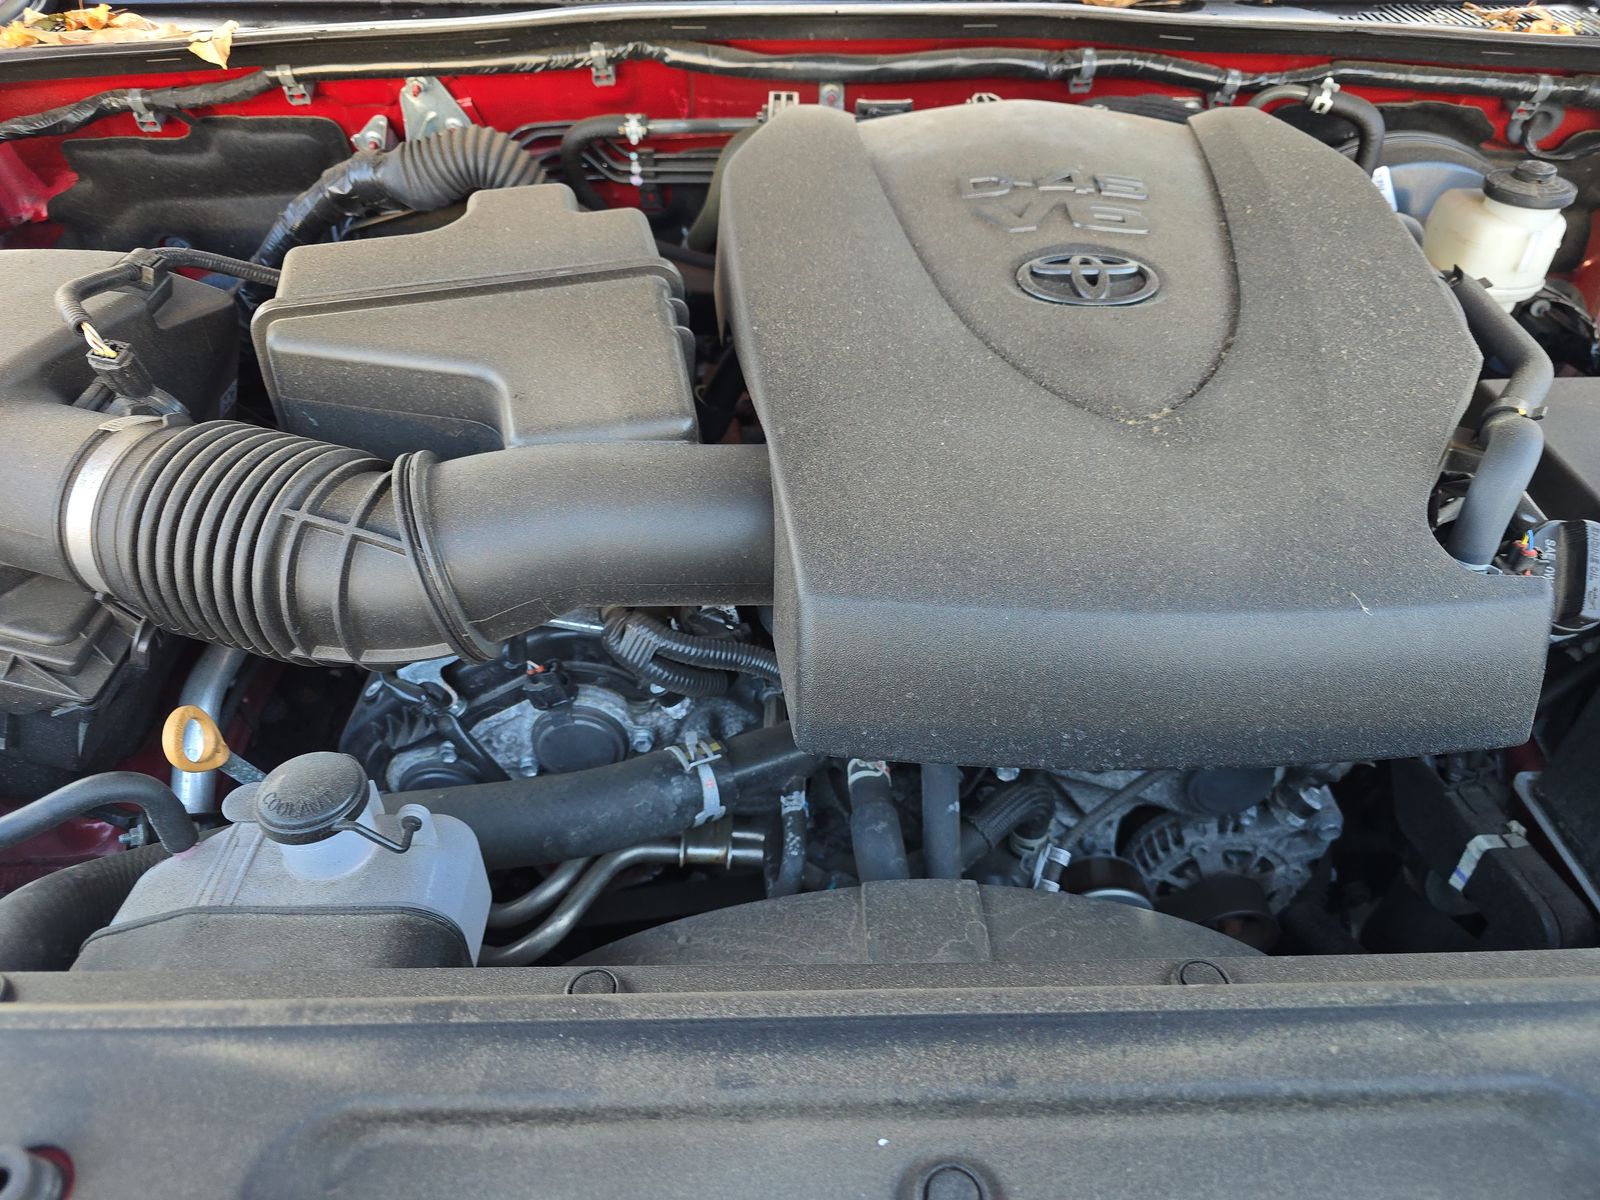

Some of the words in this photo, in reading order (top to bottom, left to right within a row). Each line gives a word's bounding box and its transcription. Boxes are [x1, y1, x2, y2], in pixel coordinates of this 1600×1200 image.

[958, 168, 1150, 200] D-4S
[969, 200, 1150, 235] V6
[262, 791, 336, 819] COOLANT
